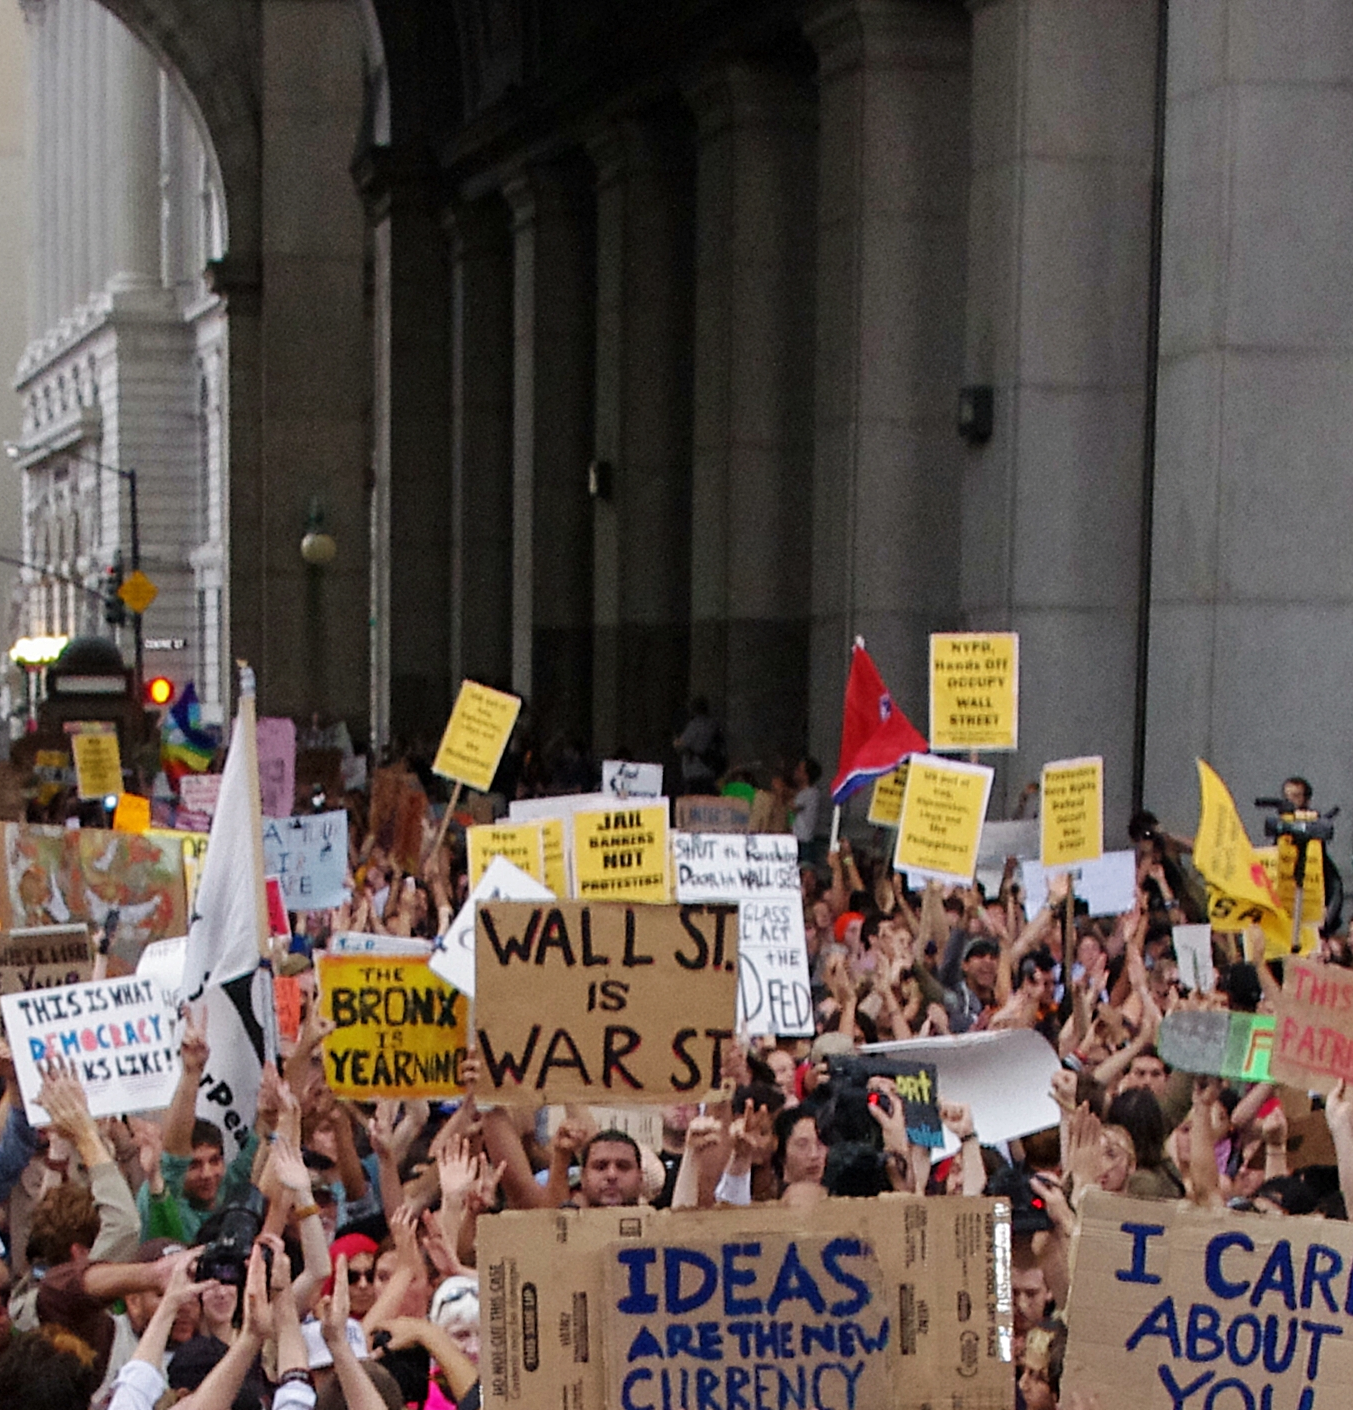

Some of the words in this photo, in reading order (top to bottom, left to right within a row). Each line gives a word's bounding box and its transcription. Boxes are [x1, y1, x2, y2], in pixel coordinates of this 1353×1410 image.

[957, 697, 992, 709] WALL
[597, 810, 643, 831] JAIL
[603, 852, 643, 869] NOT
[478, 906, 655, 969] WALL
[673, 902, 739, 973] ST.
[359, 966, 405, 983] THE
[587, 979, 630, 1013] IS
[1294, 966, 1353, 1012] THIS
[18, 987, 82, 1027] THIS
[87, 983, 109, 1014] IS
[108, 978, 154, 1010] WHAT
[331, 986, 461, 1029] BRONX
[28, 1013, 163, 1064] DEMOCRACY
[375, 1031, 404, 1050] IS
[477, 1023, 644, 1091] WAR
[114, 1048, 174, 1077] LIKE!
[616, 1236, 873, 1317] IDEAS
[1115, 1222, 1165, 1285] I
[628, 1324, 724, 1363] ARE
[727, 1322, 795, 1359] THE
[802, 1316, 890, 1357] NEW
[1125, 1295, 1344, 1381] ABOUT
